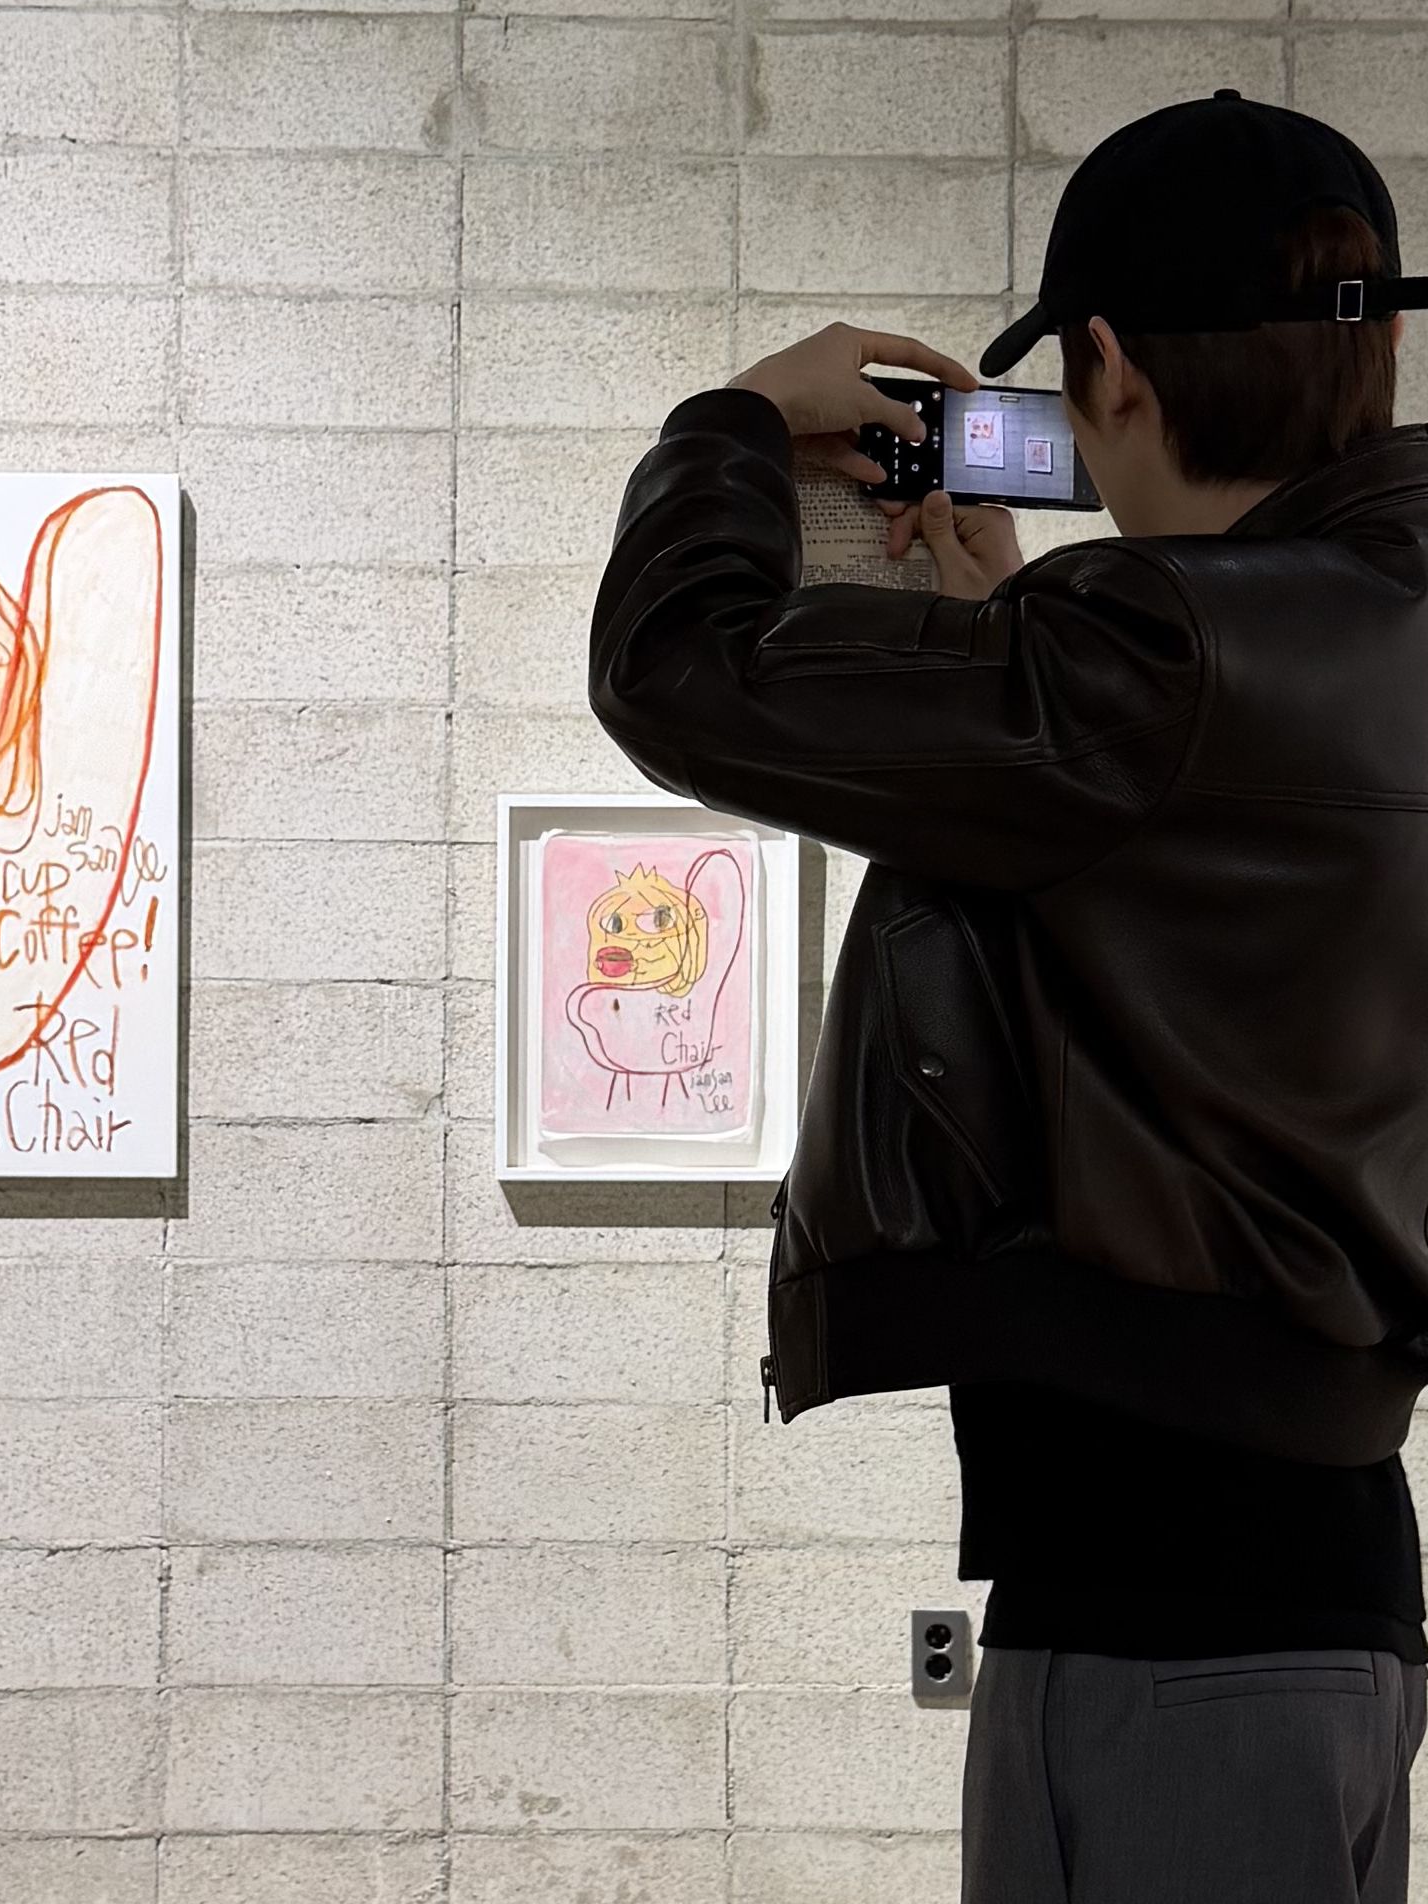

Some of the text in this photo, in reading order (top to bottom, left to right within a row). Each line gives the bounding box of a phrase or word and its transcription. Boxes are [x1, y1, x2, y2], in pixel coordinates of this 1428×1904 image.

[655, 998, 692, 1026] Red
[12, 990, 120, 1097] Red
[661, 1030, 724, 1065] Chair
[5, 1078, 133, 1154] Chair
